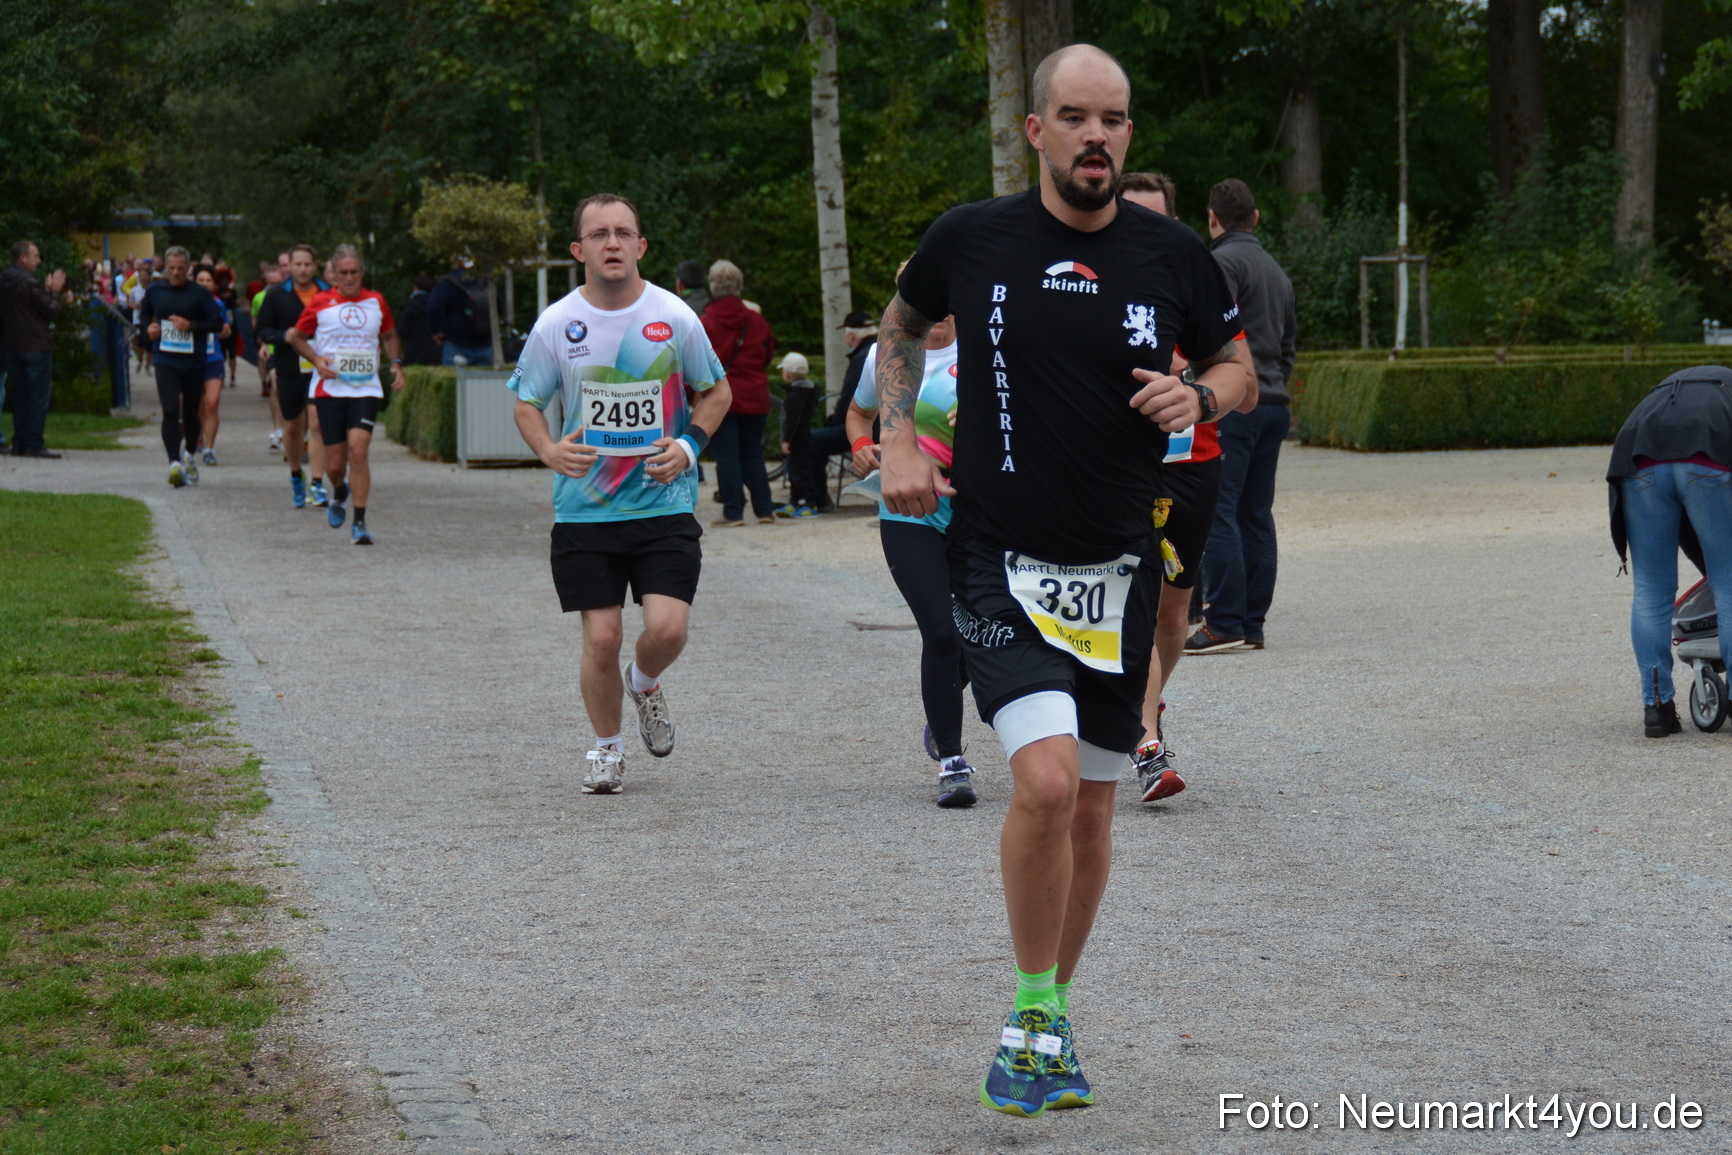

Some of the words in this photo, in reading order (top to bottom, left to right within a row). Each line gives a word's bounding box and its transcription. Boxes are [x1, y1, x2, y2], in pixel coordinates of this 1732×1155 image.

[1042, 277, 1099, 294] skinfit
[568, 345, 590, 355] PARTL
[568, 351, 591, 360] Neumarkt
[340, 358, 373, 373] 2055
[988, 285, 1016, 473] BAVARTRIA
[583, 388, 610, 397] PARTL
[611, 389, 649, 398] Neumarkt
[591, 399, 656, 428] 2493
[603, 434, 644, 446] Damian
[1058, 563, 1114, 577] Neumarkt
[1035, 578, 1106, 625] 330
